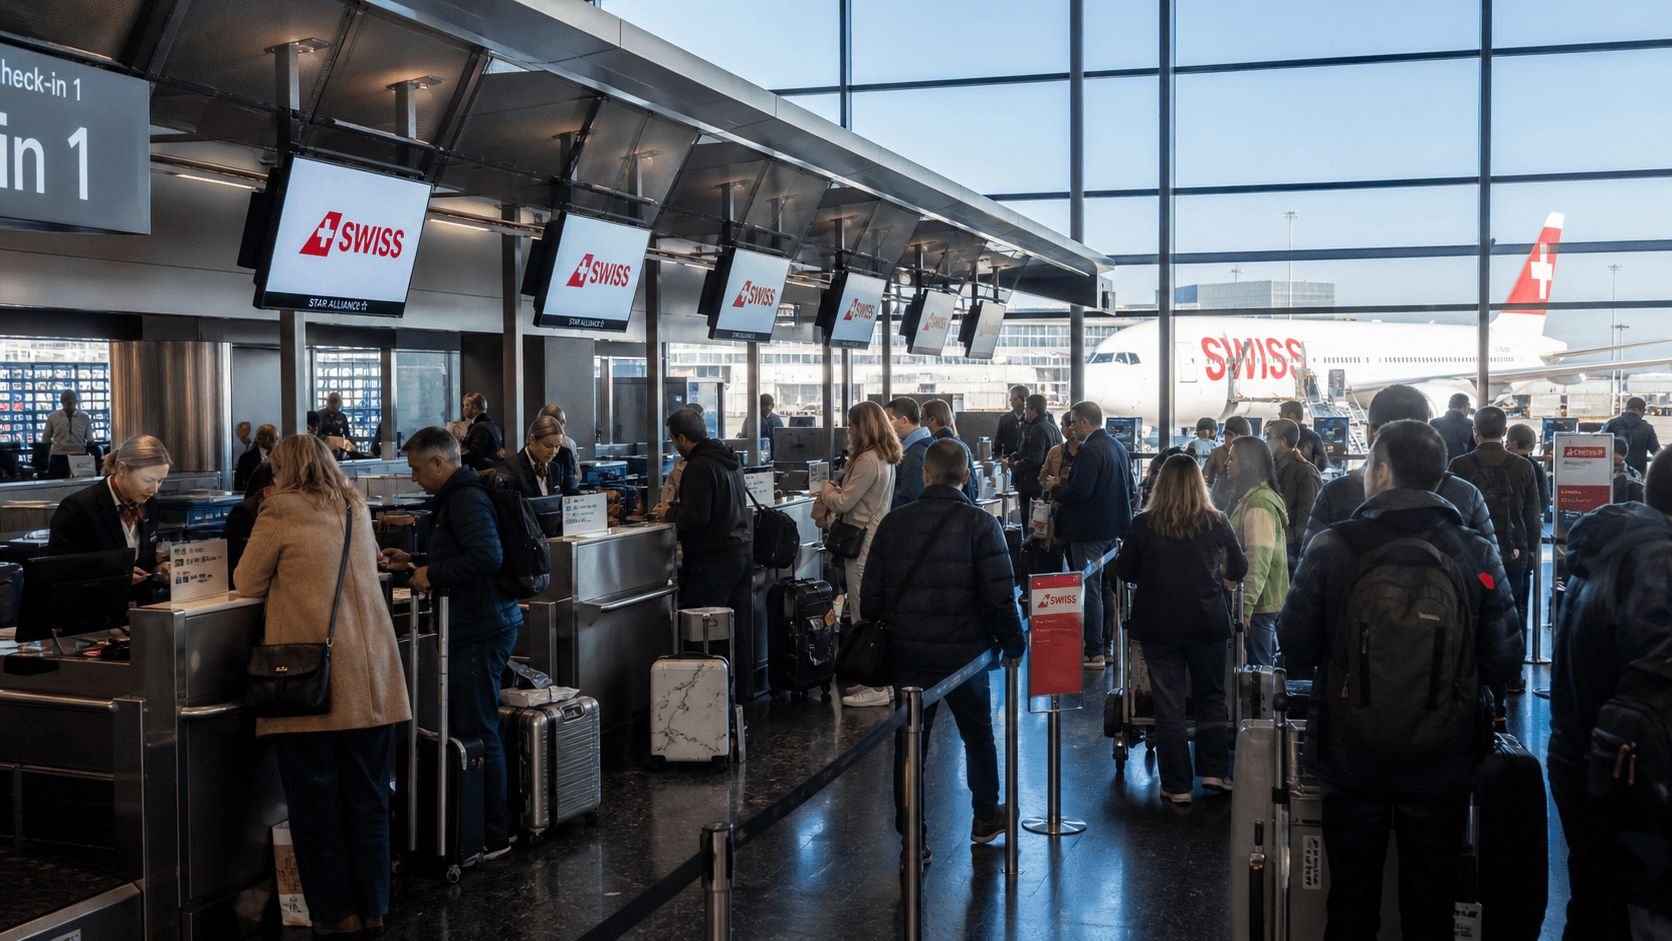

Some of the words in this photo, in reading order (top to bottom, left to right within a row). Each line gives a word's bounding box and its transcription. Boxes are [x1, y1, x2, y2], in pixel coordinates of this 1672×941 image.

[1, 59, 67, 98] heck-in
[73, 78, 81, 101] 1
[67, 127, 88, 201] 1
[338, 221, 405, 259] SWISS
[589, 260, 631, 288] SWISS
[308, 298, 328, 308] STAR
[747, 285, 776, 307] SWISS
[1201, 337, 1306, 381] SWISS
[1050, 594, 1077, 605] SWISS
